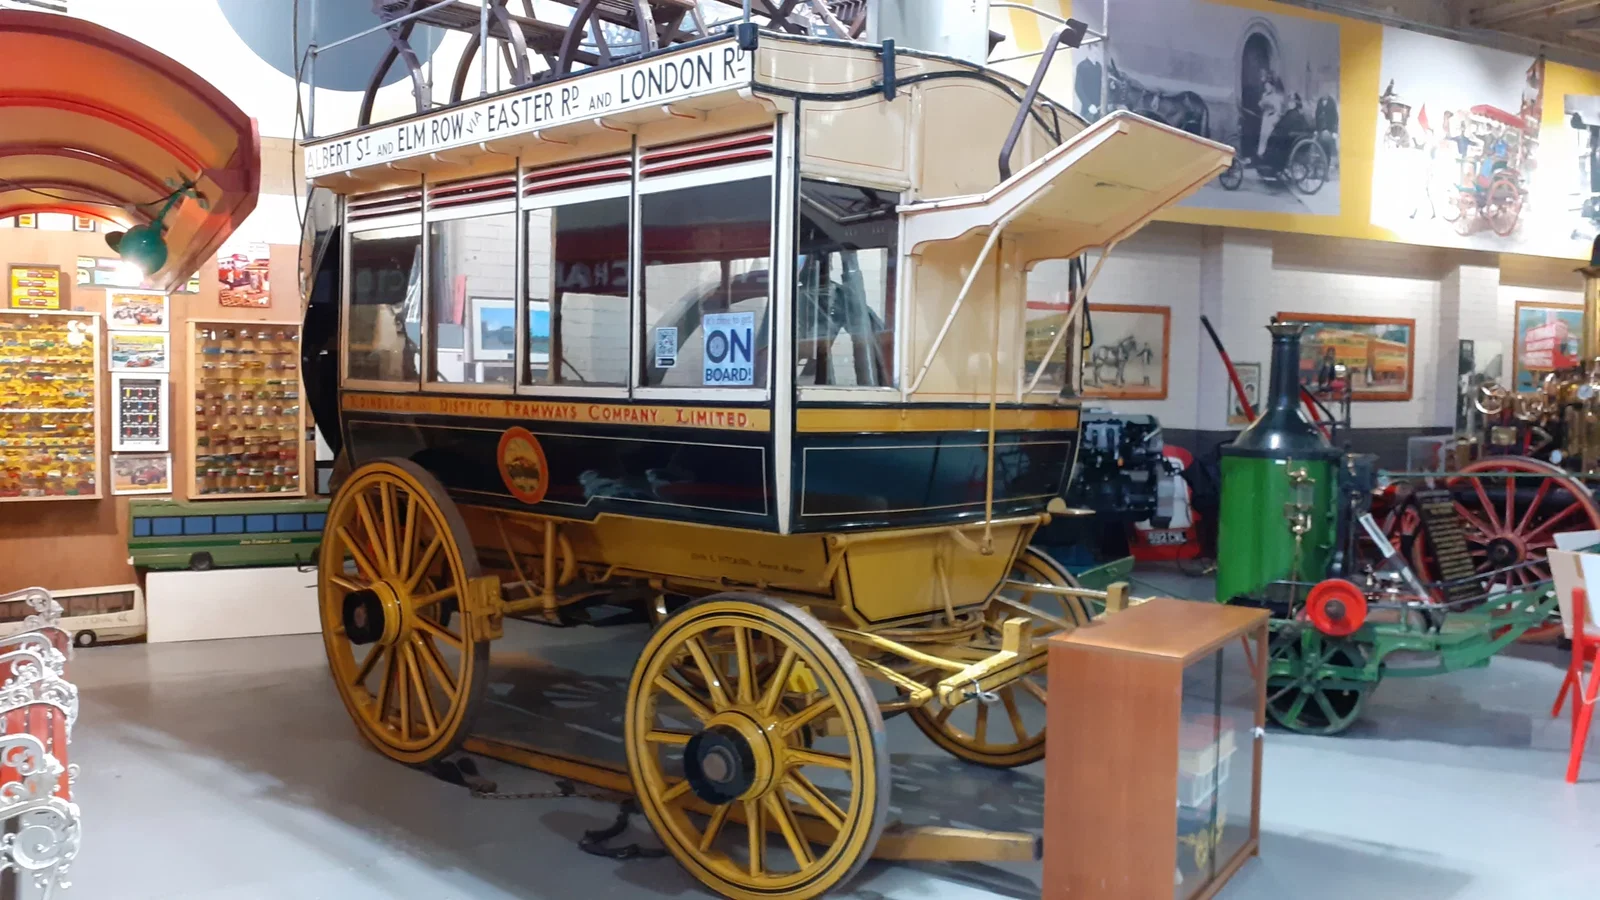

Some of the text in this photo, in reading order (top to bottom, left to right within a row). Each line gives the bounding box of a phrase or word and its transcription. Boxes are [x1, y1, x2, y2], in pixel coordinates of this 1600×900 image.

[307, 140, 351, 173] ALBERT
[377, 141, 394, 157] AND
[398, 121, 426, 152] ELM
[431, 113, 464, 145] ROW
[466, 111, 483, 134] VIA
[488, 90, 553, 133] EASTER
[589, 92, 612, 111] AND
[621, 52, 713, 104] LONDON
[706, 328, 752, 364] ON
[705, 367, 752, 382] BOARD!
[439, 399, 491, 415] DISTRICT
[504, 401, 577, 419] TRAMWAYS
